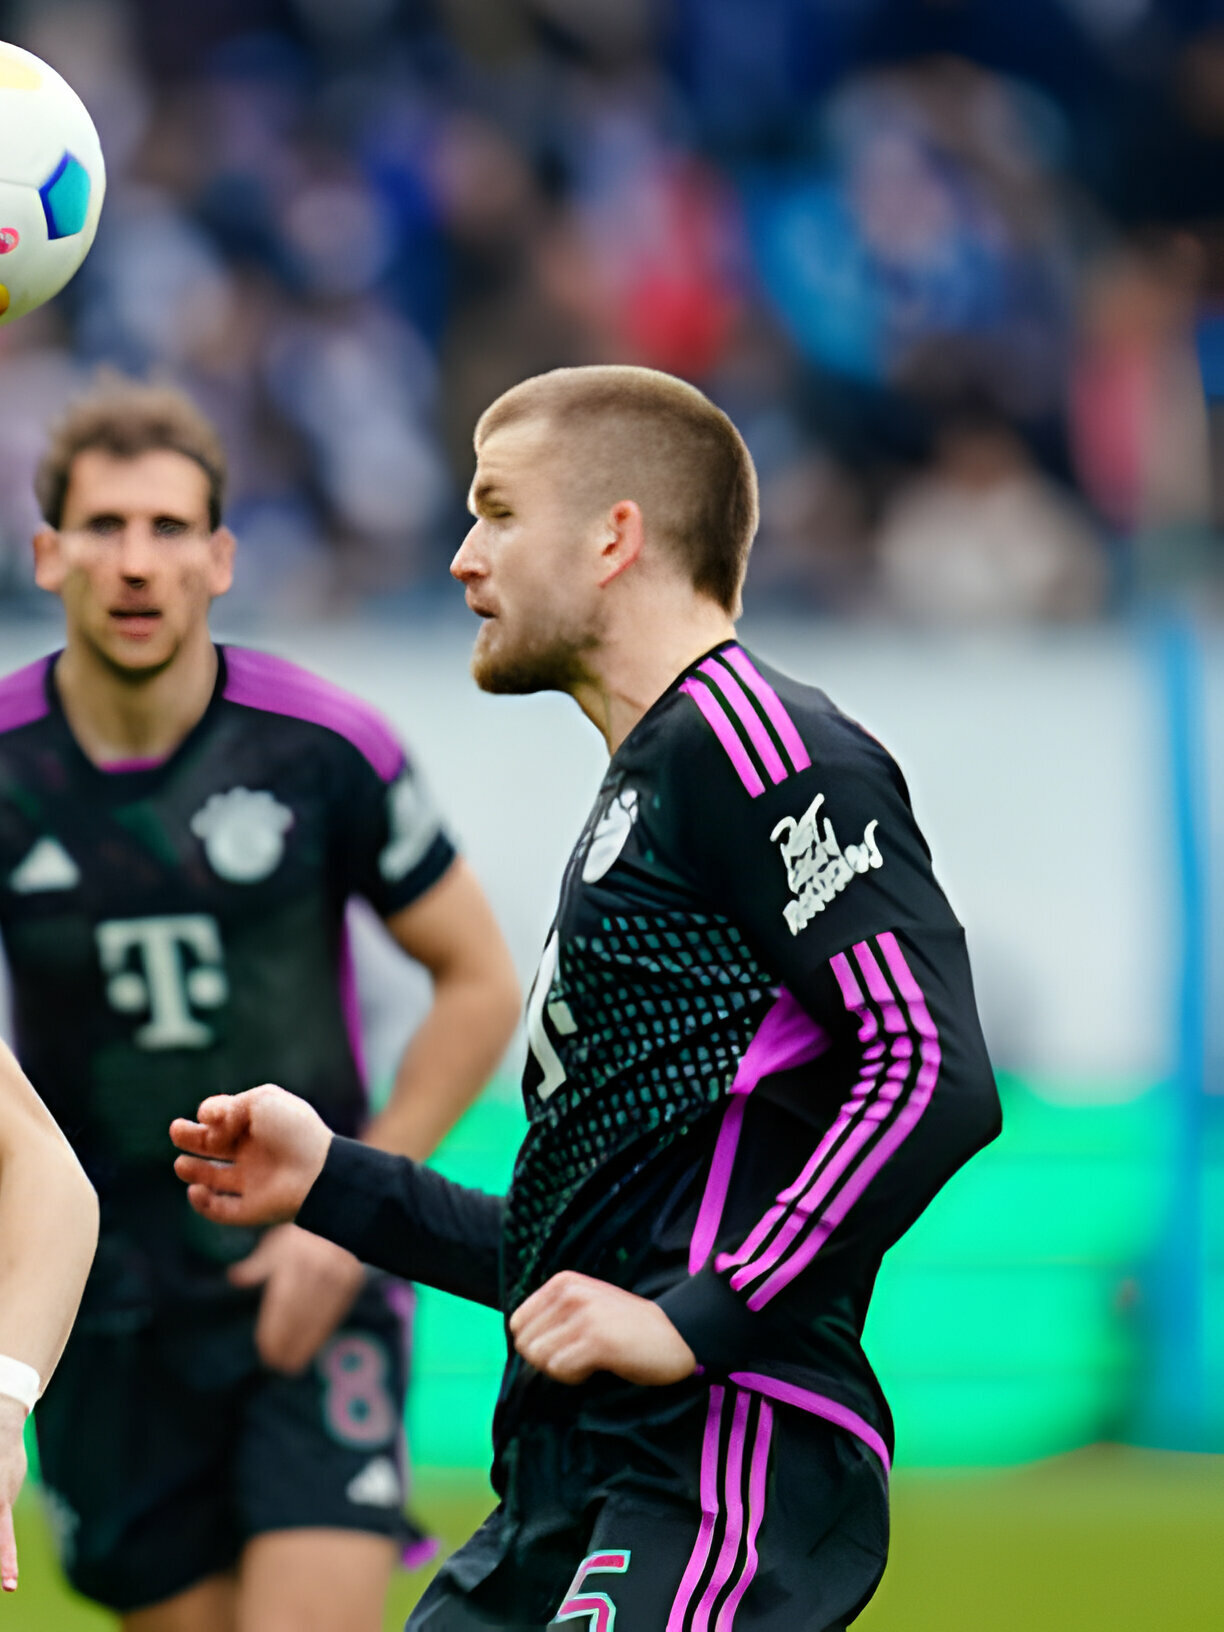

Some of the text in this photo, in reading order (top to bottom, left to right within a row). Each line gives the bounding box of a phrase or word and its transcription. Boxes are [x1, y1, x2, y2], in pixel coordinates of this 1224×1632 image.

[95, 914, 228, 1050] T
[319, 1333, 397, 1449] 8
[556, 1549, 631, 1632] 5
